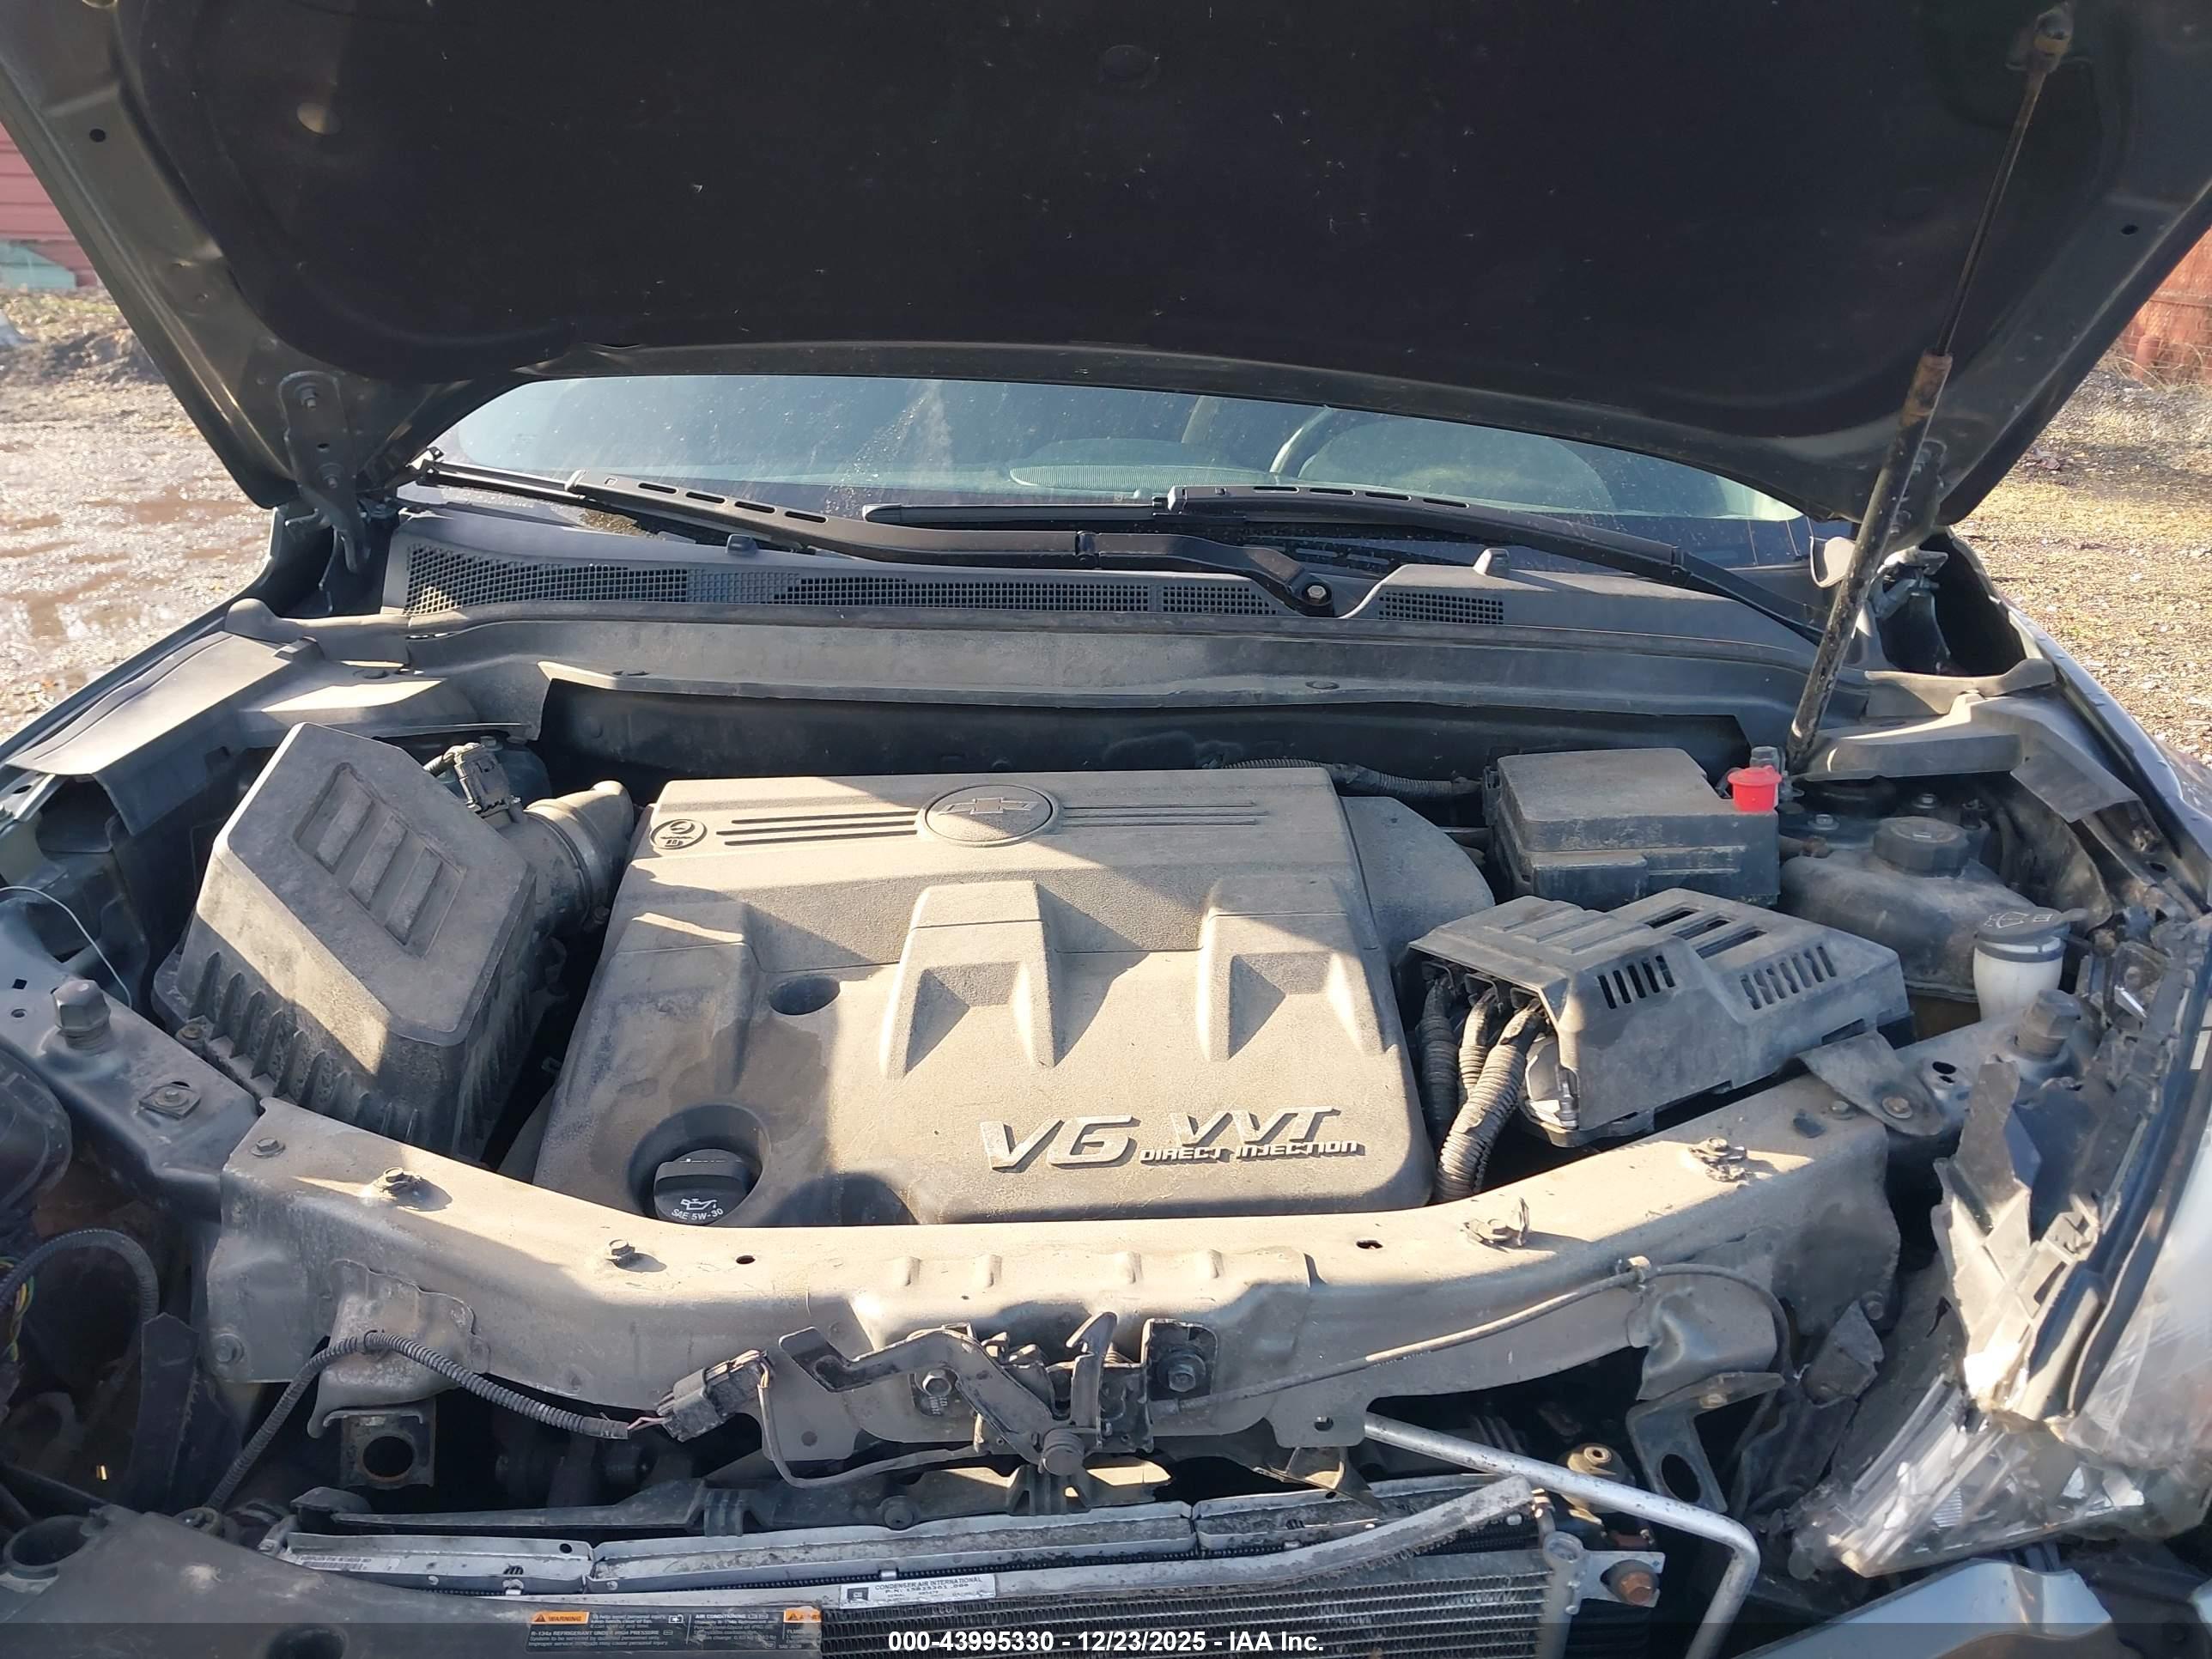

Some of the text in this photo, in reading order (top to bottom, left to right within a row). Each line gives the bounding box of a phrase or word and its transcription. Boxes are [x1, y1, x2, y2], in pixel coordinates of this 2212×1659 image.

[980, 1105, 1340, 1173] V6 VVT
[1139, 1140, 1365, 1165] DIRECT INJECTION
[672, 1208, 724, 1221] SAE 5W-30
